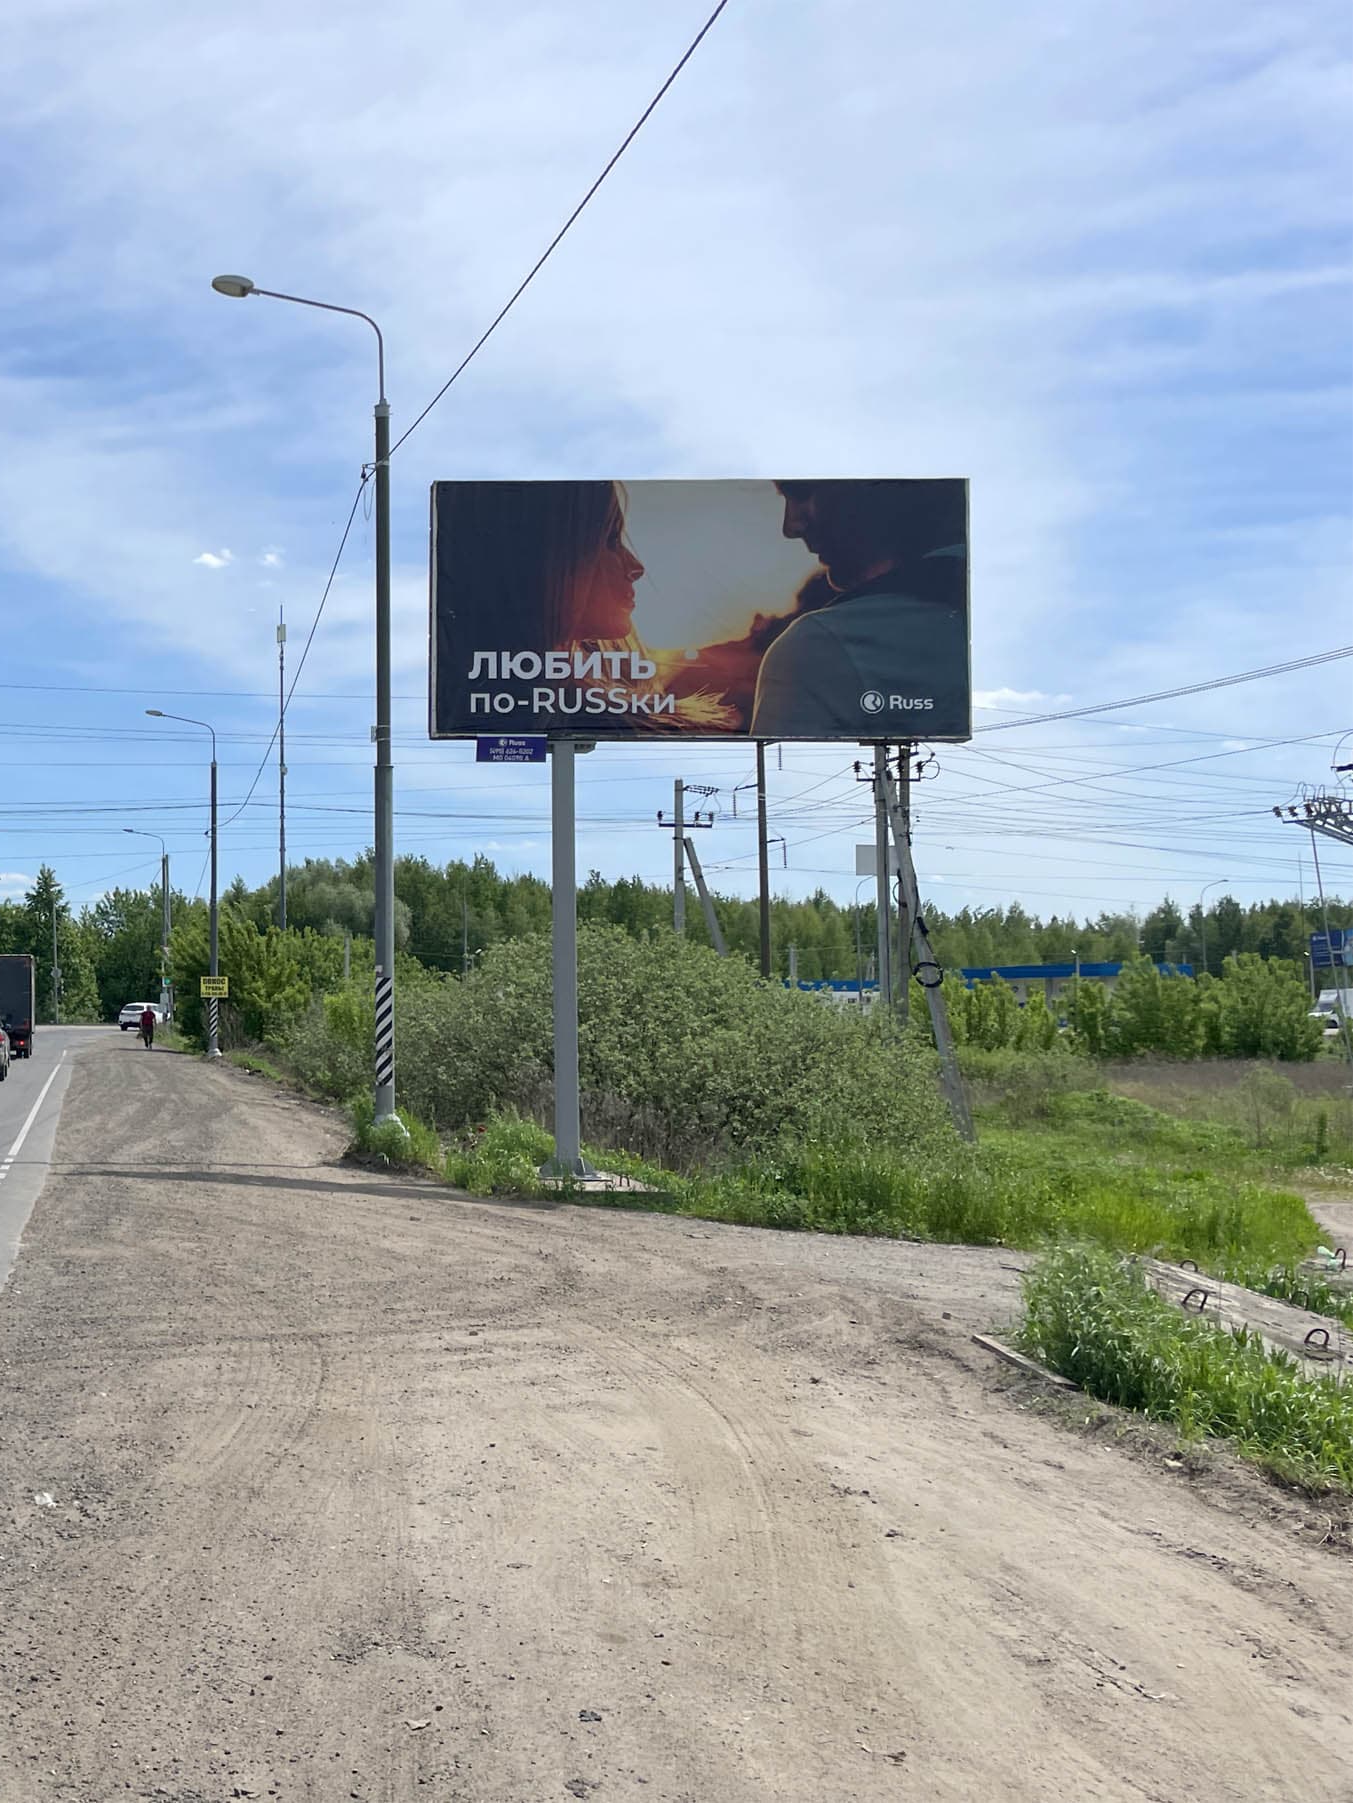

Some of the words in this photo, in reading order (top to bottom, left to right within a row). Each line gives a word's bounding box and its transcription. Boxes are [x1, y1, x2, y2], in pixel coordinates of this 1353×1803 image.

[467, 650, 657, 680] ЛЮБИТЬ
[470, 687, 676, 714] по-RUSSки
[889, 694, 934, 710] Russ
